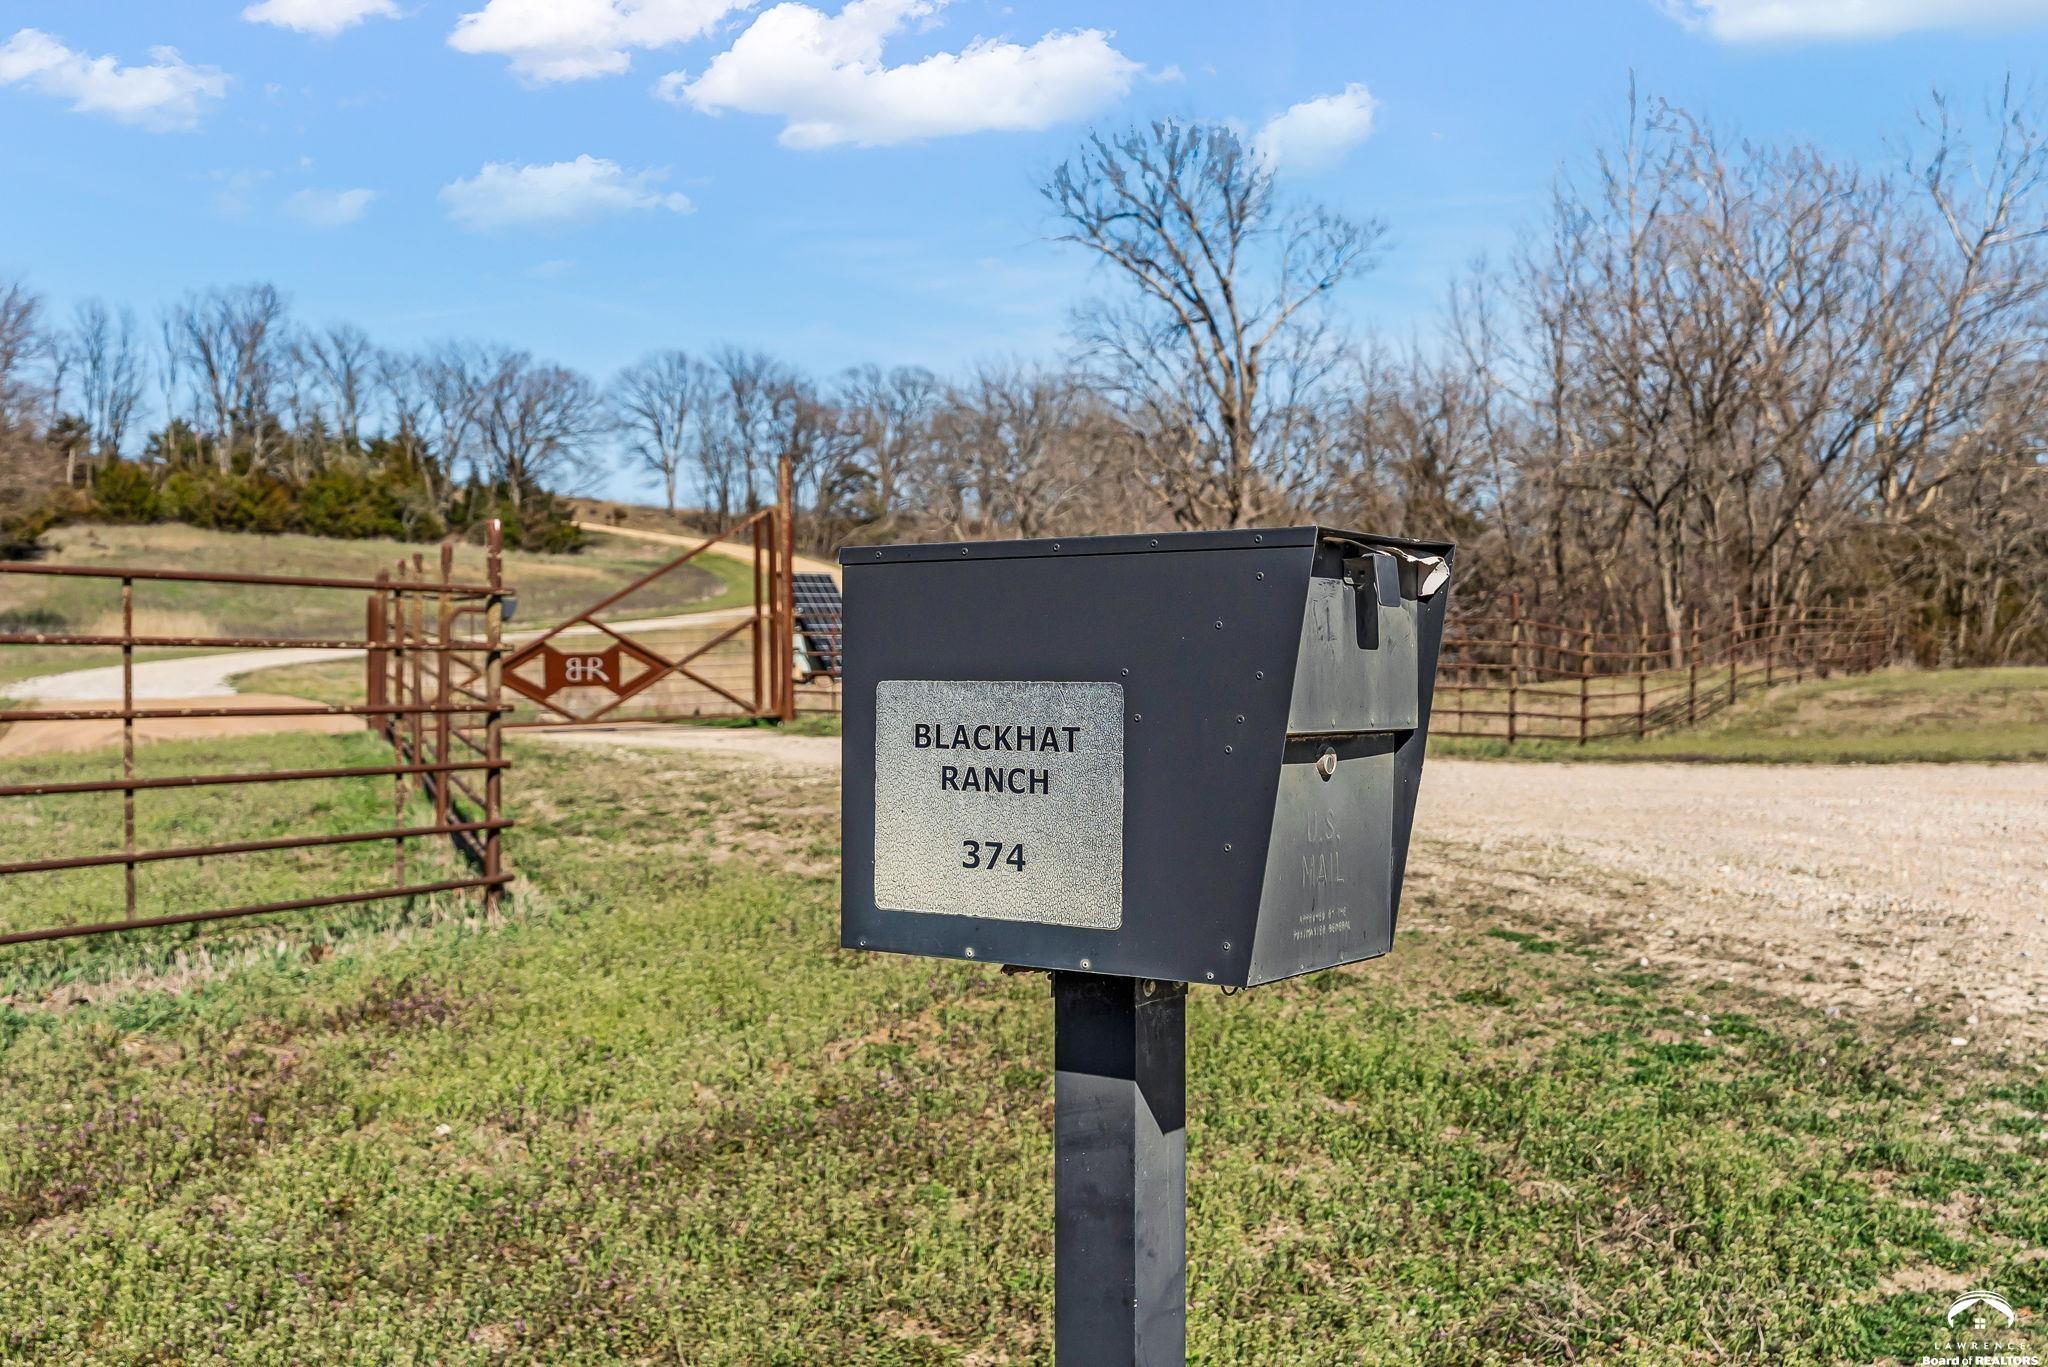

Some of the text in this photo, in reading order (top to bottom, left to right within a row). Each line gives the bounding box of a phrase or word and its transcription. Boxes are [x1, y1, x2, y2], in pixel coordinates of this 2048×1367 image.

[914, 723, 1081, 753] BLACKHAT
[941, 765, 1049, 795] RANCH
[1306, 808, 1341, 842] U.S.
[961, 840, 1026, 871] 374
[1302, 851, 1345, 888] MAIL
